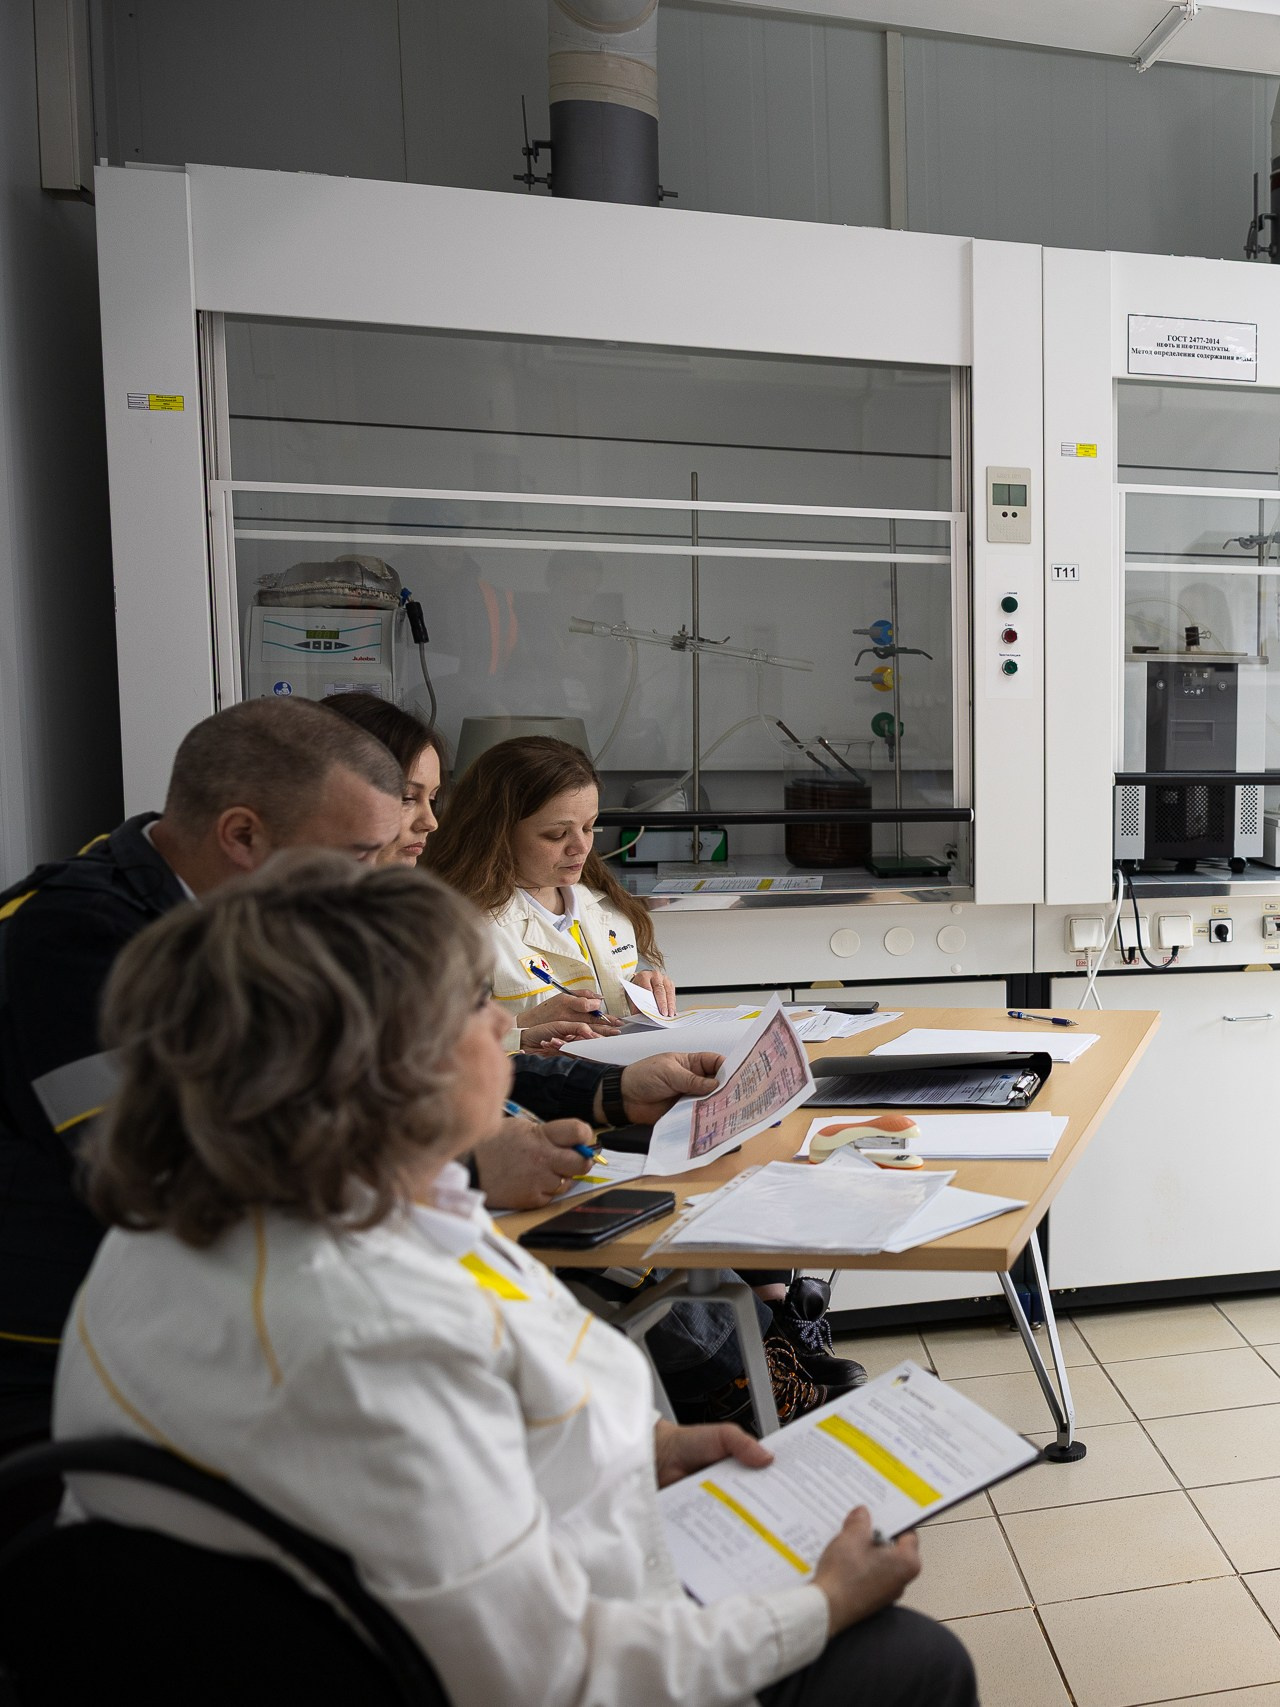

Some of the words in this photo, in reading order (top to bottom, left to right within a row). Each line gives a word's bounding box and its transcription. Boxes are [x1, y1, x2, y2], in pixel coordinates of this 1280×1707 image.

[1167, 334, 1187, 342] ГОСТ
[1189, 336, 1220, 345] 2477-2014
[1131, 347, 1153, 355] Метод
[1153, 350, 1195, 358] определения
[1196, 353, 1235, 361] содержания
